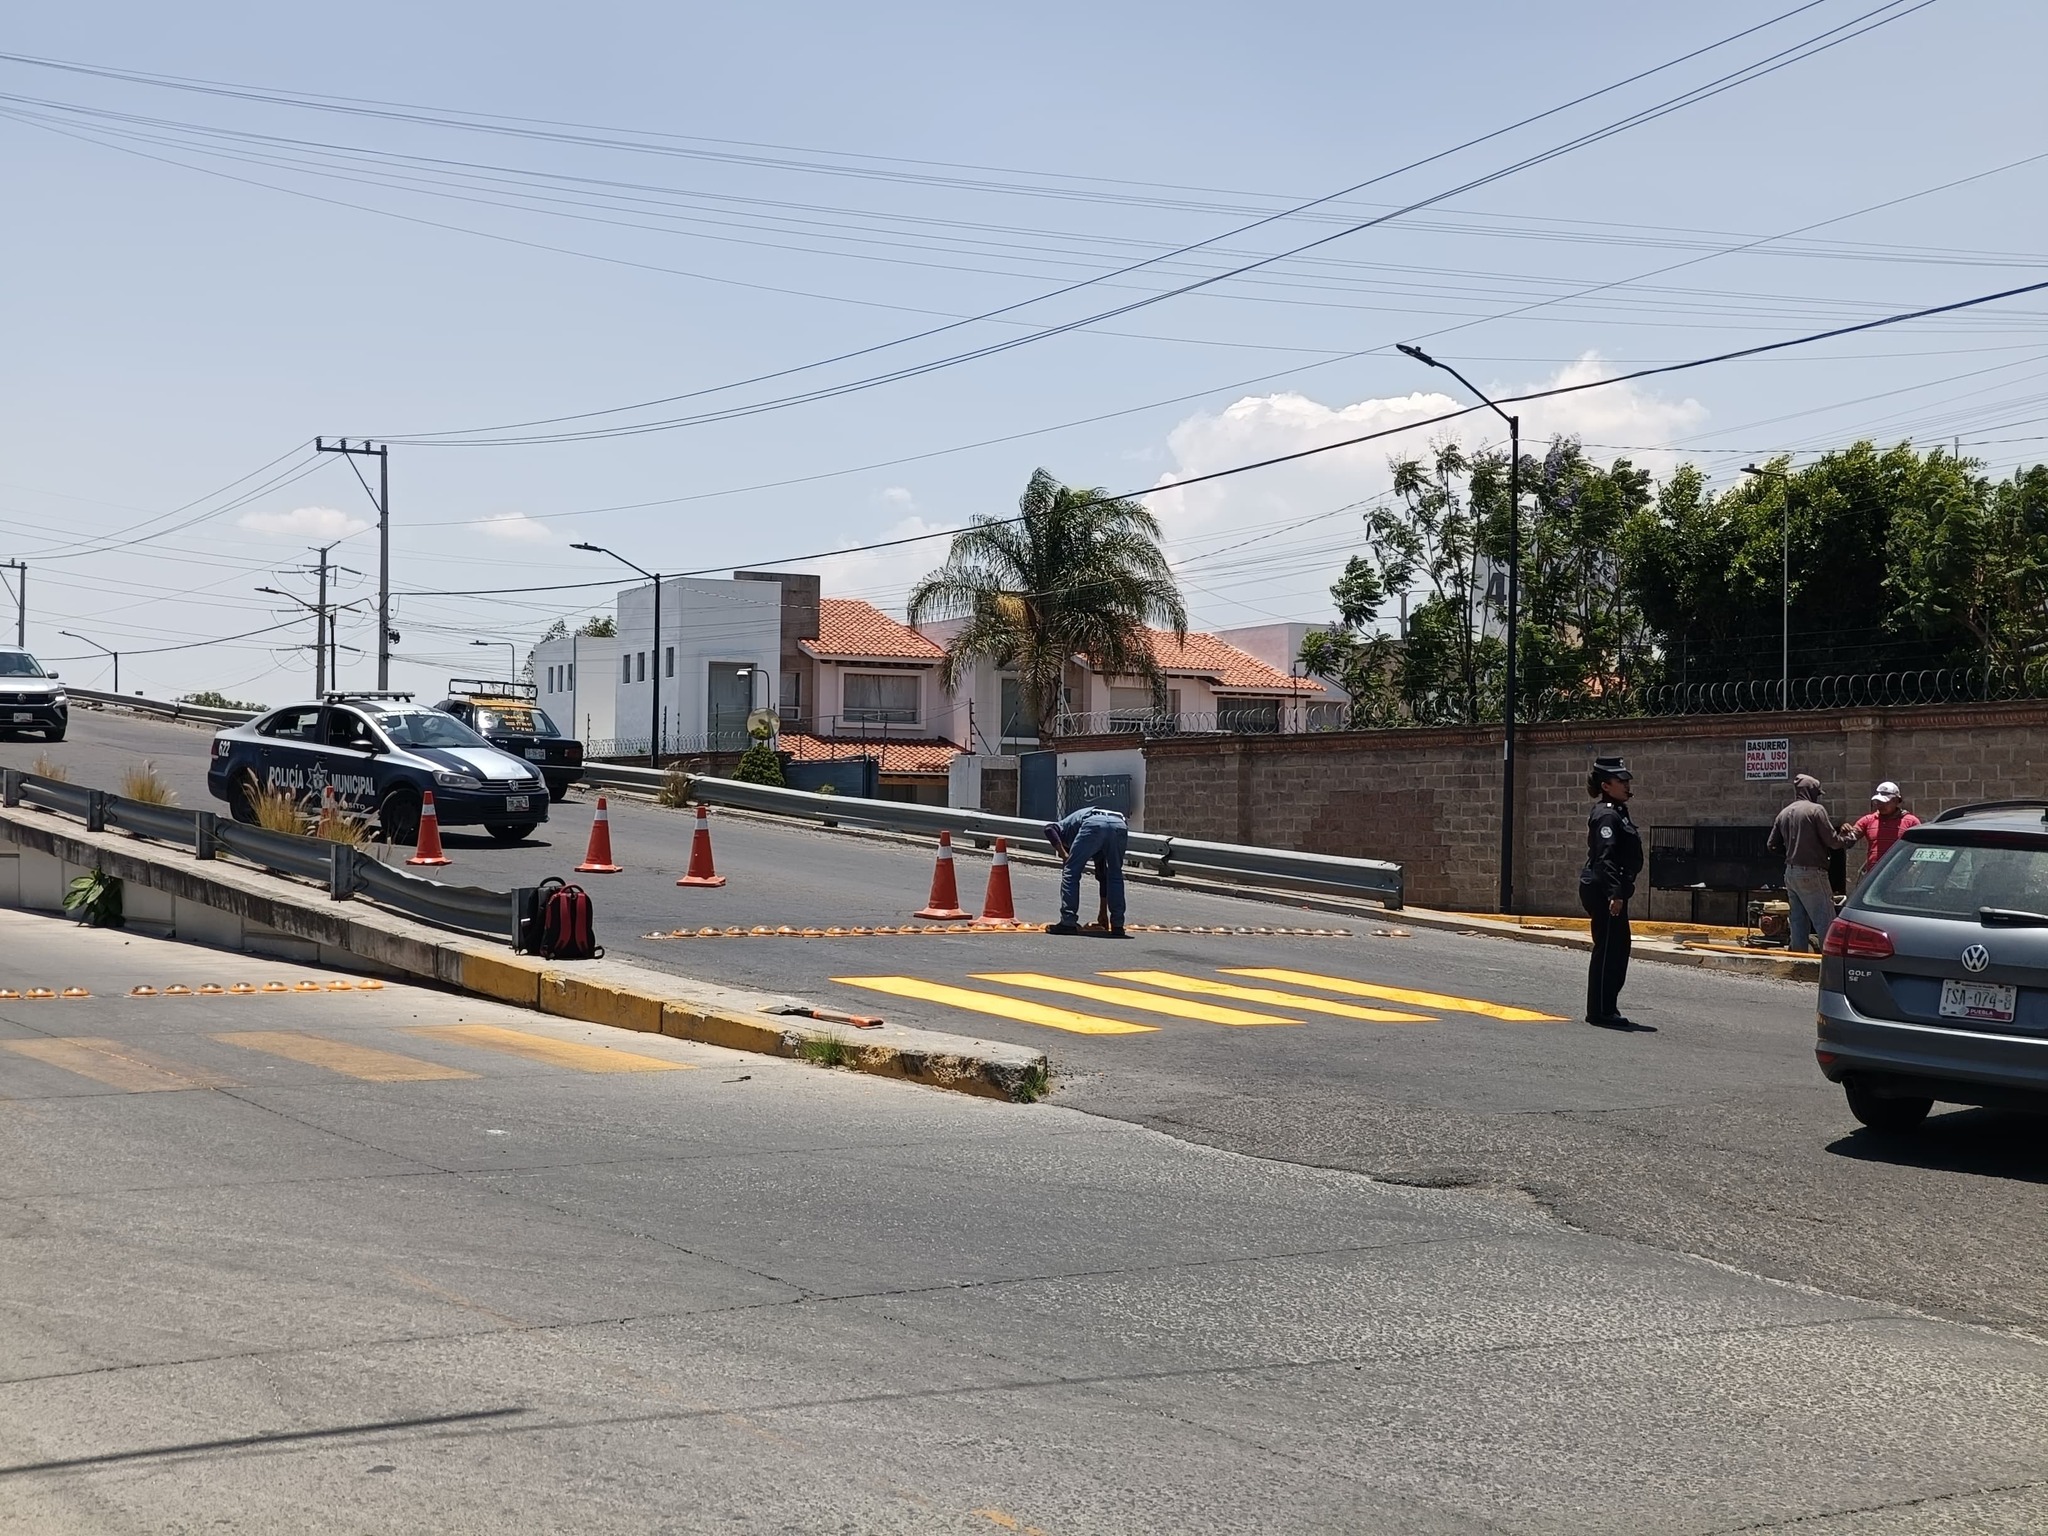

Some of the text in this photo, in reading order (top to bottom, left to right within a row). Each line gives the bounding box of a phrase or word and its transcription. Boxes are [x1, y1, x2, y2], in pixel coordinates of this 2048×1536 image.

[218, 740, 230, 757] 622
[1747, 741, 1787, 751] BASURERO
[1747, 751, 1787, 761] PARA USO
[1747, 762, 1787, 771] EXCLUSIVO
[269, 764, 376, 796] POLICÍA MUNICIPAL
[1848, 969, 1872, 977] GOLF
[1970, 1008, 1994, 1016] PUEBLA
